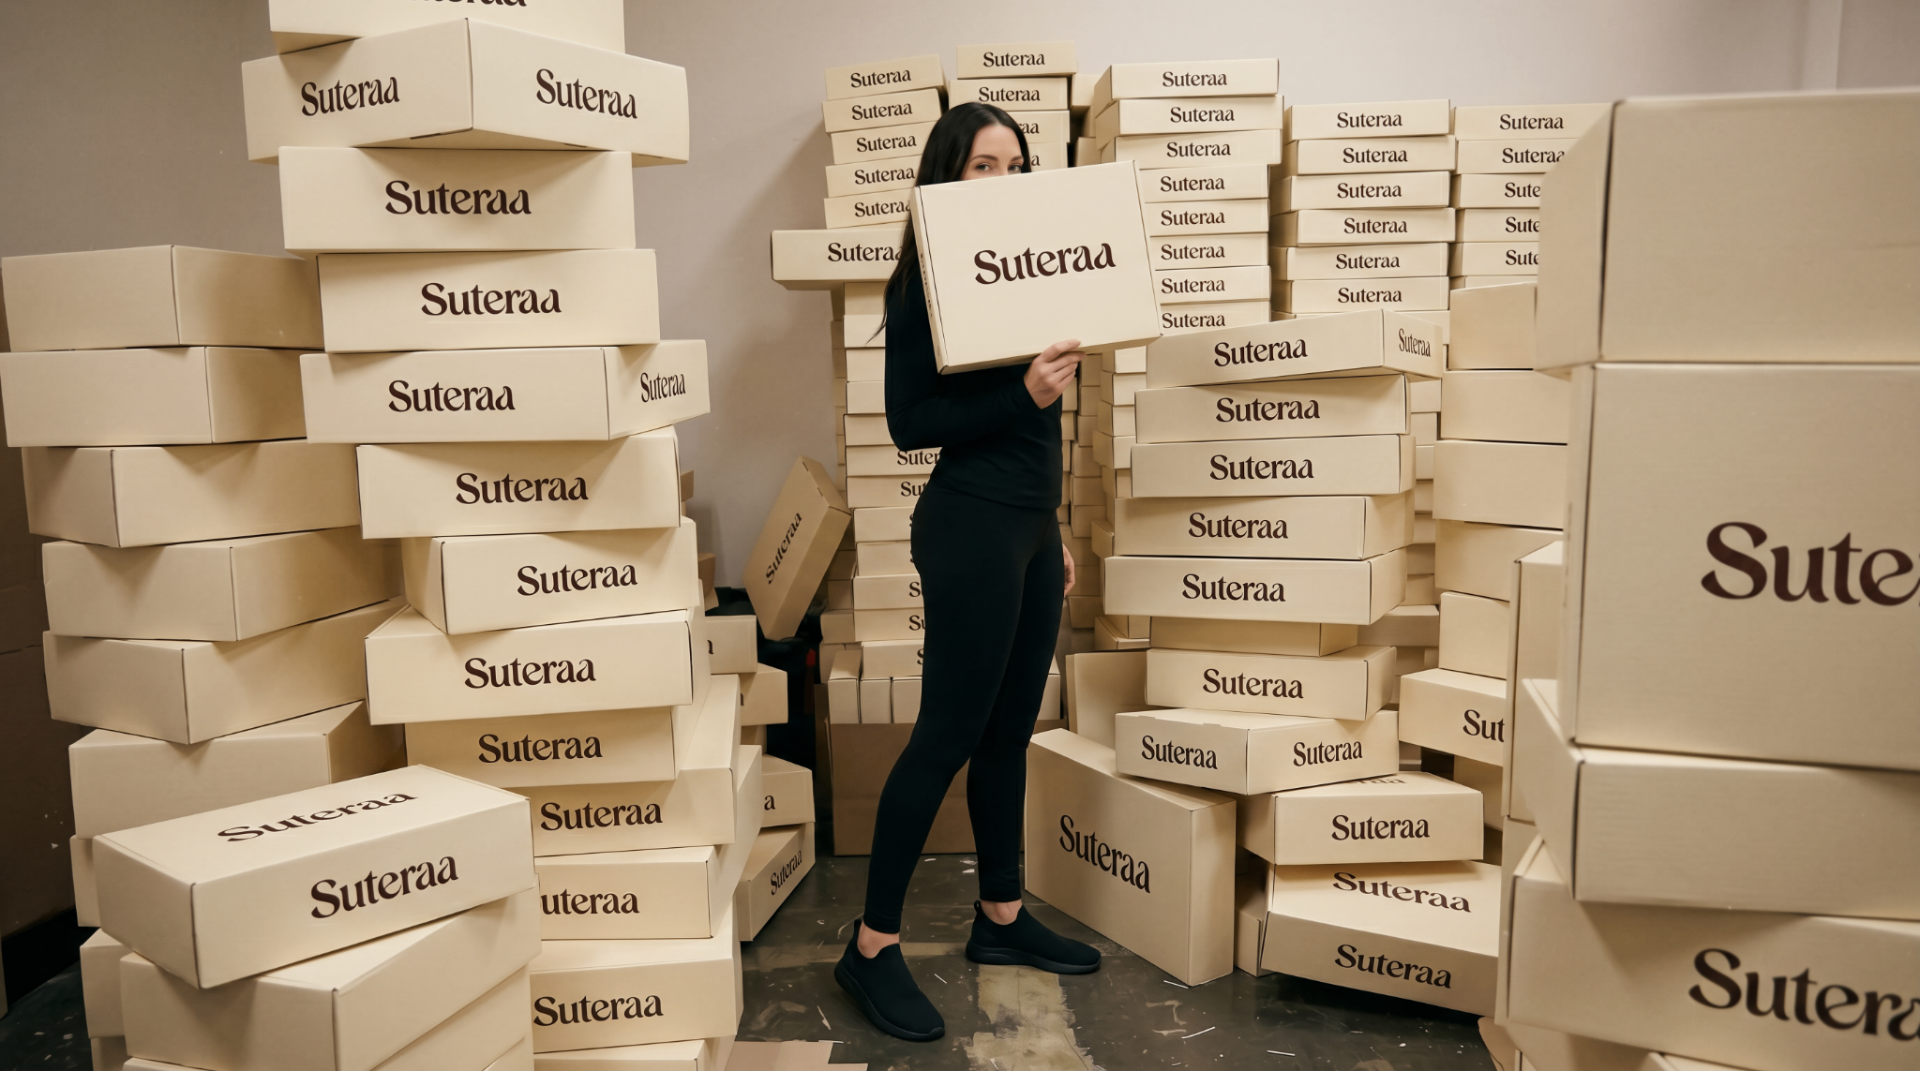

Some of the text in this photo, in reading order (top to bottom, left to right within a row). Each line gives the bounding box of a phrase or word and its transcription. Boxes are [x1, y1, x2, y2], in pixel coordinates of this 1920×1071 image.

[983, 52, 1045, 67] Suteraa
[851, 70, 911, 88] Suteraa
[1163, 72, 1227, 87] Suteraa
[301, 77, 399, 116] Suteraa
[537, 69, 637, 119] Suteraa
[979, 87, 1040, 102] Suteraa
[852, 104, 912, 120] Suteraa
[1170, 107, 1234, 123] Suteraa
[1337, 112, 1402, 128] Suteraa
[1500, 114, 1563, 129] Suteraa
[857, 136, 916, 152] Suteraa
[1167, 142, 1230, 157] Suteraa
[1343, 148, 1408, 163] Suteraa
[855, 168, 915, 185] Suteraa
[1161, 176, 1224, 192] Suteraa
[386, 181, 531, 214] Suteraa
[1337, 183, 1402, 198] Suteraa
[1161, 210, 1225, 225] Suteraa
[1344, 218, 1407, 233] Suteraa
[974, 243, 1116, 284] Suteraa
[1161, 244, 1225, 260] Suteraa
[1336, 254, 1400, 269] Suteraa
[1161, 278, 1225, 293] Suteraa
[1338, 288, 1402, 303] Suteraa
[422, 283, 561, 315] Suteraa
[1162, 313, 1225, 328] Suteraa
[1214, 339, 1307, 367] Suteraa
[1399, 328, 1431, 357] Suteraa
[389, 380, 515, 412] Suteraa
[640, 373, 685, 402] Suteraa
[1216, 398, 1320, 422] Suteraa
[1210, 455, 1314, 480] Suteraa
[456, 473, 588, 504] Suteraa
[1189, 512, 1288, 538] Suteraa
[766, 513, 802, 585] Suteraa
[517, 565, 638, 596] Suteraa
[1182, 574, 1285, 602] Suteraa
[465, 658, 596, 688] Suteraa
[1203, 669, 1303, 698] Suteraa
[479, 734, 602, 763] Suteraa
[1142, 735, 1217, 769] Suteraa
[1294, 741, 1362, 766] Suteraa
[217, 793, 418, 842] Suteraa
[541, 802, 662, 830] Suteraa
[1332, 815, 1430, 840] Suteraa
[1059, 815, 1151, 894] Suteraa
[771, 851, 802, 895] Suteraa
[311, 857, 458, 918] Suteraa
[1333, 872, 1471, 912] Suteraa
[1335, 945, 1451, 989] Suteraa
[533, 996, 663, 1026] Suteraa
